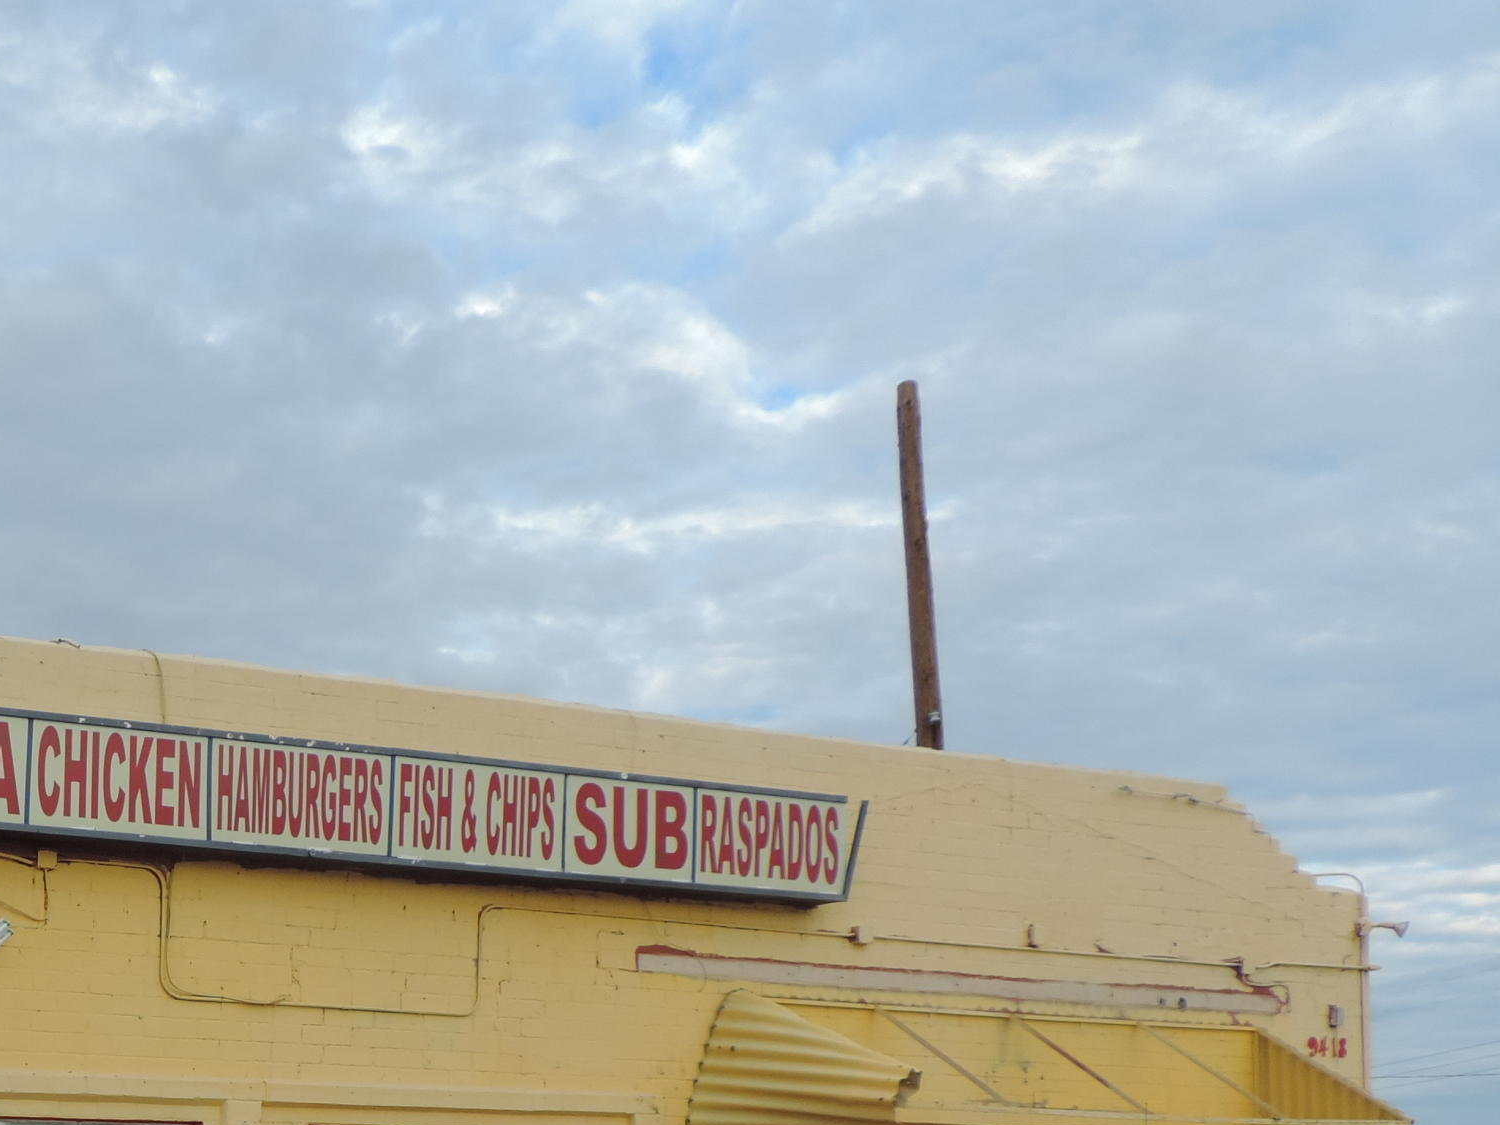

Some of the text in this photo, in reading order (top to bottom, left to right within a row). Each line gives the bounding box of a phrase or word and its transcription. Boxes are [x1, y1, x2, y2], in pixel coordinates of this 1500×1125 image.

[37, 725, 202, 829] CHICKEN
[217, 744, 383, 846] HAMBURGERS
[400, 764, 453, 850] FISH
[461, 769, 477, 854] &
[487, 771, 554, 860] CHIPS
[574, 782, 688, 869] SUB
[701, 795, 839, 885] RASPADOS
[1307, 1036, 1348, 1058] 9418
